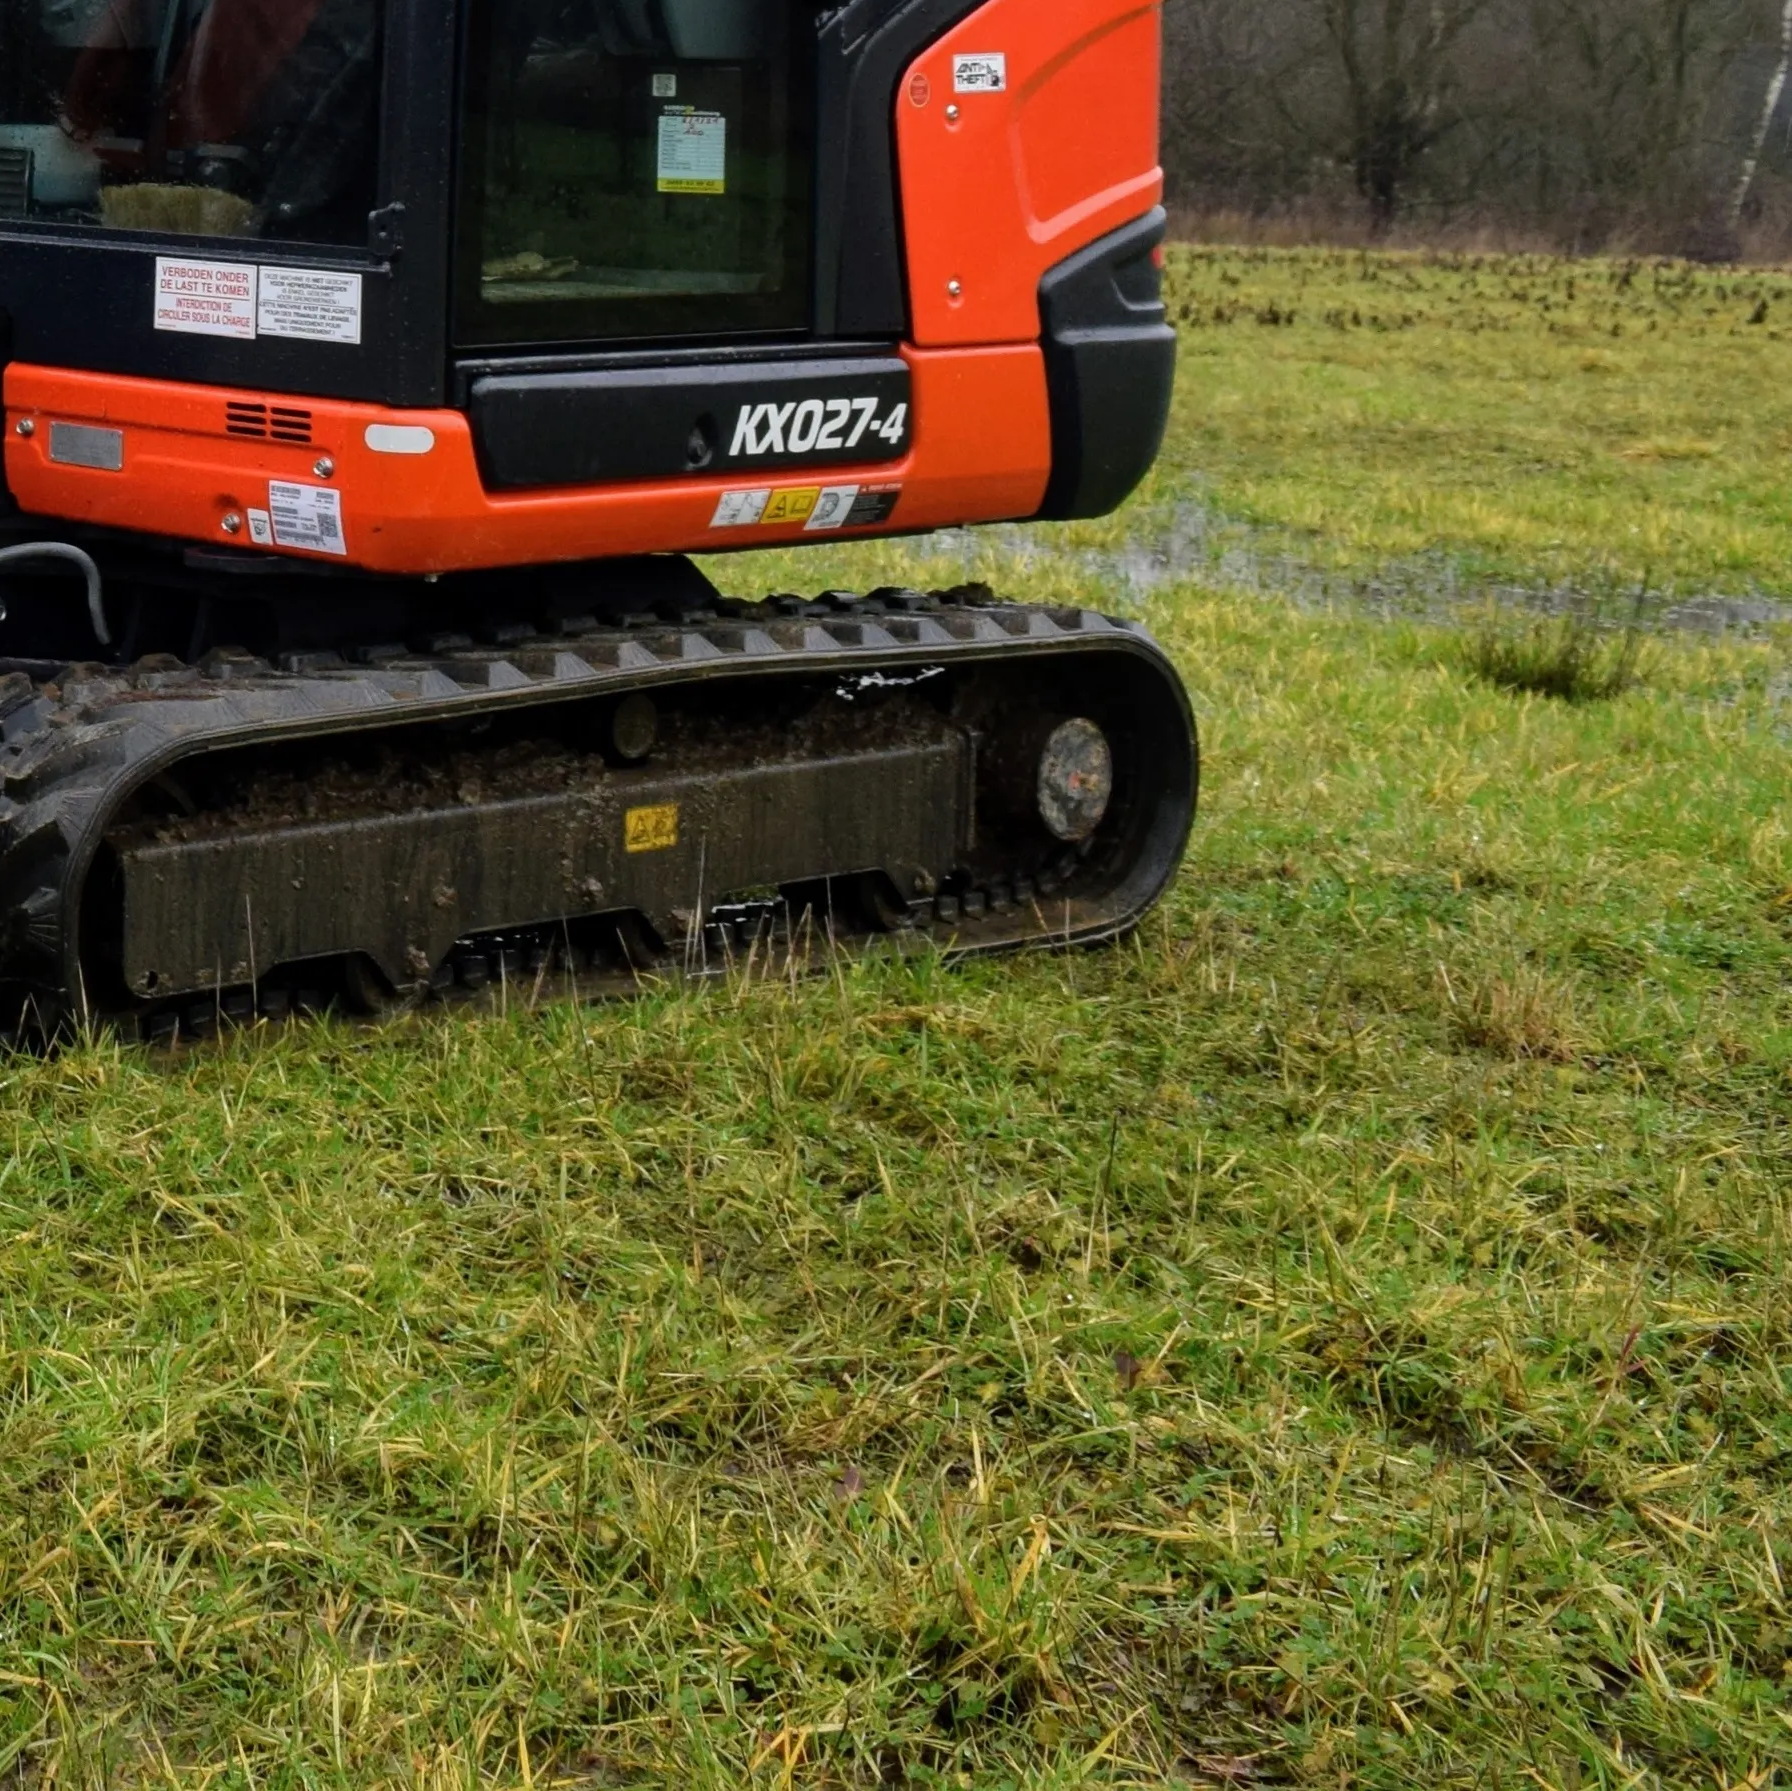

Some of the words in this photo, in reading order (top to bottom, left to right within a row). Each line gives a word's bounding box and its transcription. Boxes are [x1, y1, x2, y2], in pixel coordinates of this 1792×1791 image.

[956, 74, 985, 84] THEFT
[162, 266, 212, 280] VERBODEN
[216, 271, 248, 283] ONDER
[161, 279, 172, 289] DE
[176, 280, 198, 292] LAST
[202, 283, 212, 293] TE
[216, 284, 249, 296] KOMEN
[176, 298, 221, 311] INTERDICTION
[223, 303, 232, 312] DE
[158, 309, 190, 321] CIRCULER
[192, 312, 210, 323] SOUS
[212, 315, 220, 324] LA
[222, 316, 249, 327] CHARGE
[729, 397, 907, 456] KX027-4
